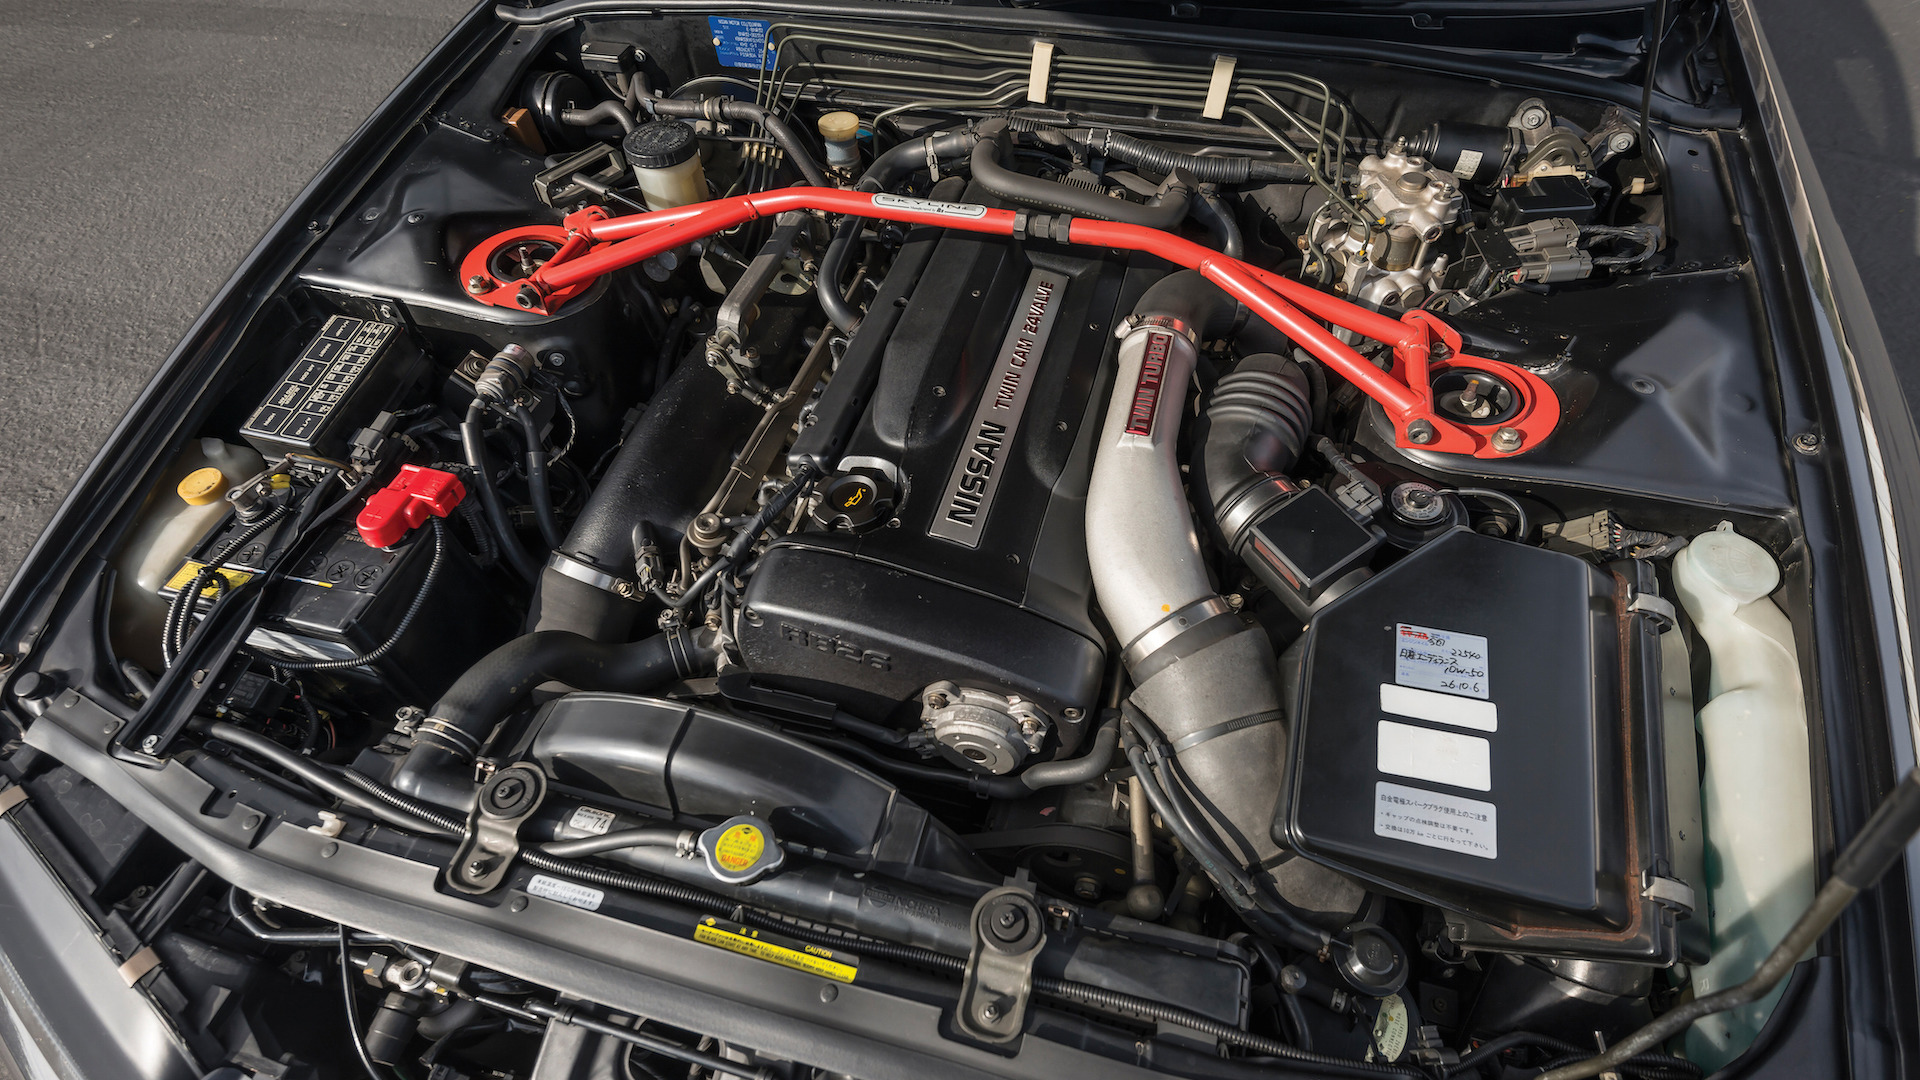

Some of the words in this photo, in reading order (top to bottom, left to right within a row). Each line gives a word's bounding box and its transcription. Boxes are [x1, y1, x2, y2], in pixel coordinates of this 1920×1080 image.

[882, 196, 977, 212] SKYLINE
[1141, 333, 1169, 385] TURBO
[946, 420, 1007, 528] NISSAN
[993, 372, 1022, 410] TWIN
[1010, 337, 1034, 369] CAM
[1022, 280, 1054, 336] 24VALVE
[1129, 387, 1155, 430] TWIN
[780, 621, 892, 672] RB26
[721, 854, 749, 867] DANGER
[804, 944, 833, 959] CAUTION
